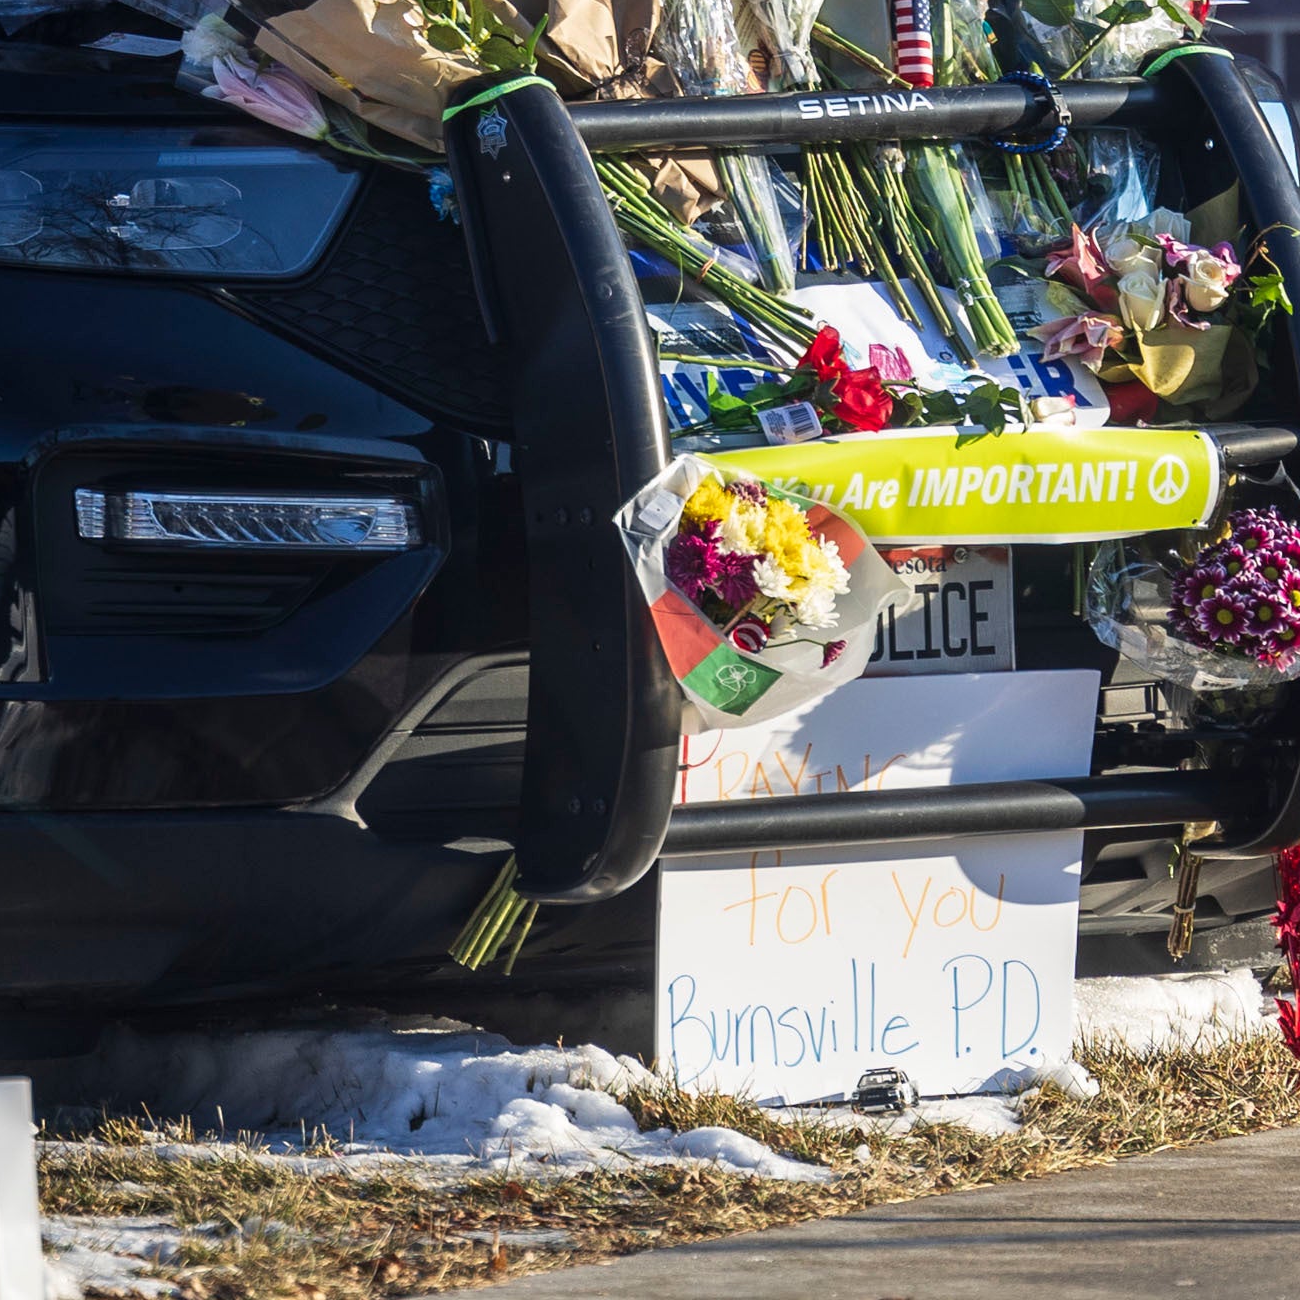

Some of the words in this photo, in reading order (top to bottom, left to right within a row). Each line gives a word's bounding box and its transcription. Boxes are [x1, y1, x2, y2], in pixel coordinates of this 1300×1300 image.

[798, 92, 935, 119] SETINA
[837, 472, 900, 511] Are
[907, 461, 1138, 507] IMPORTANT!
[723, 849, 839, 946] for
[891, 870, 1005, 959] you
[667, 957, 919, 1086] Burnsville
[942, 954, 1038, 1059] P.D.
